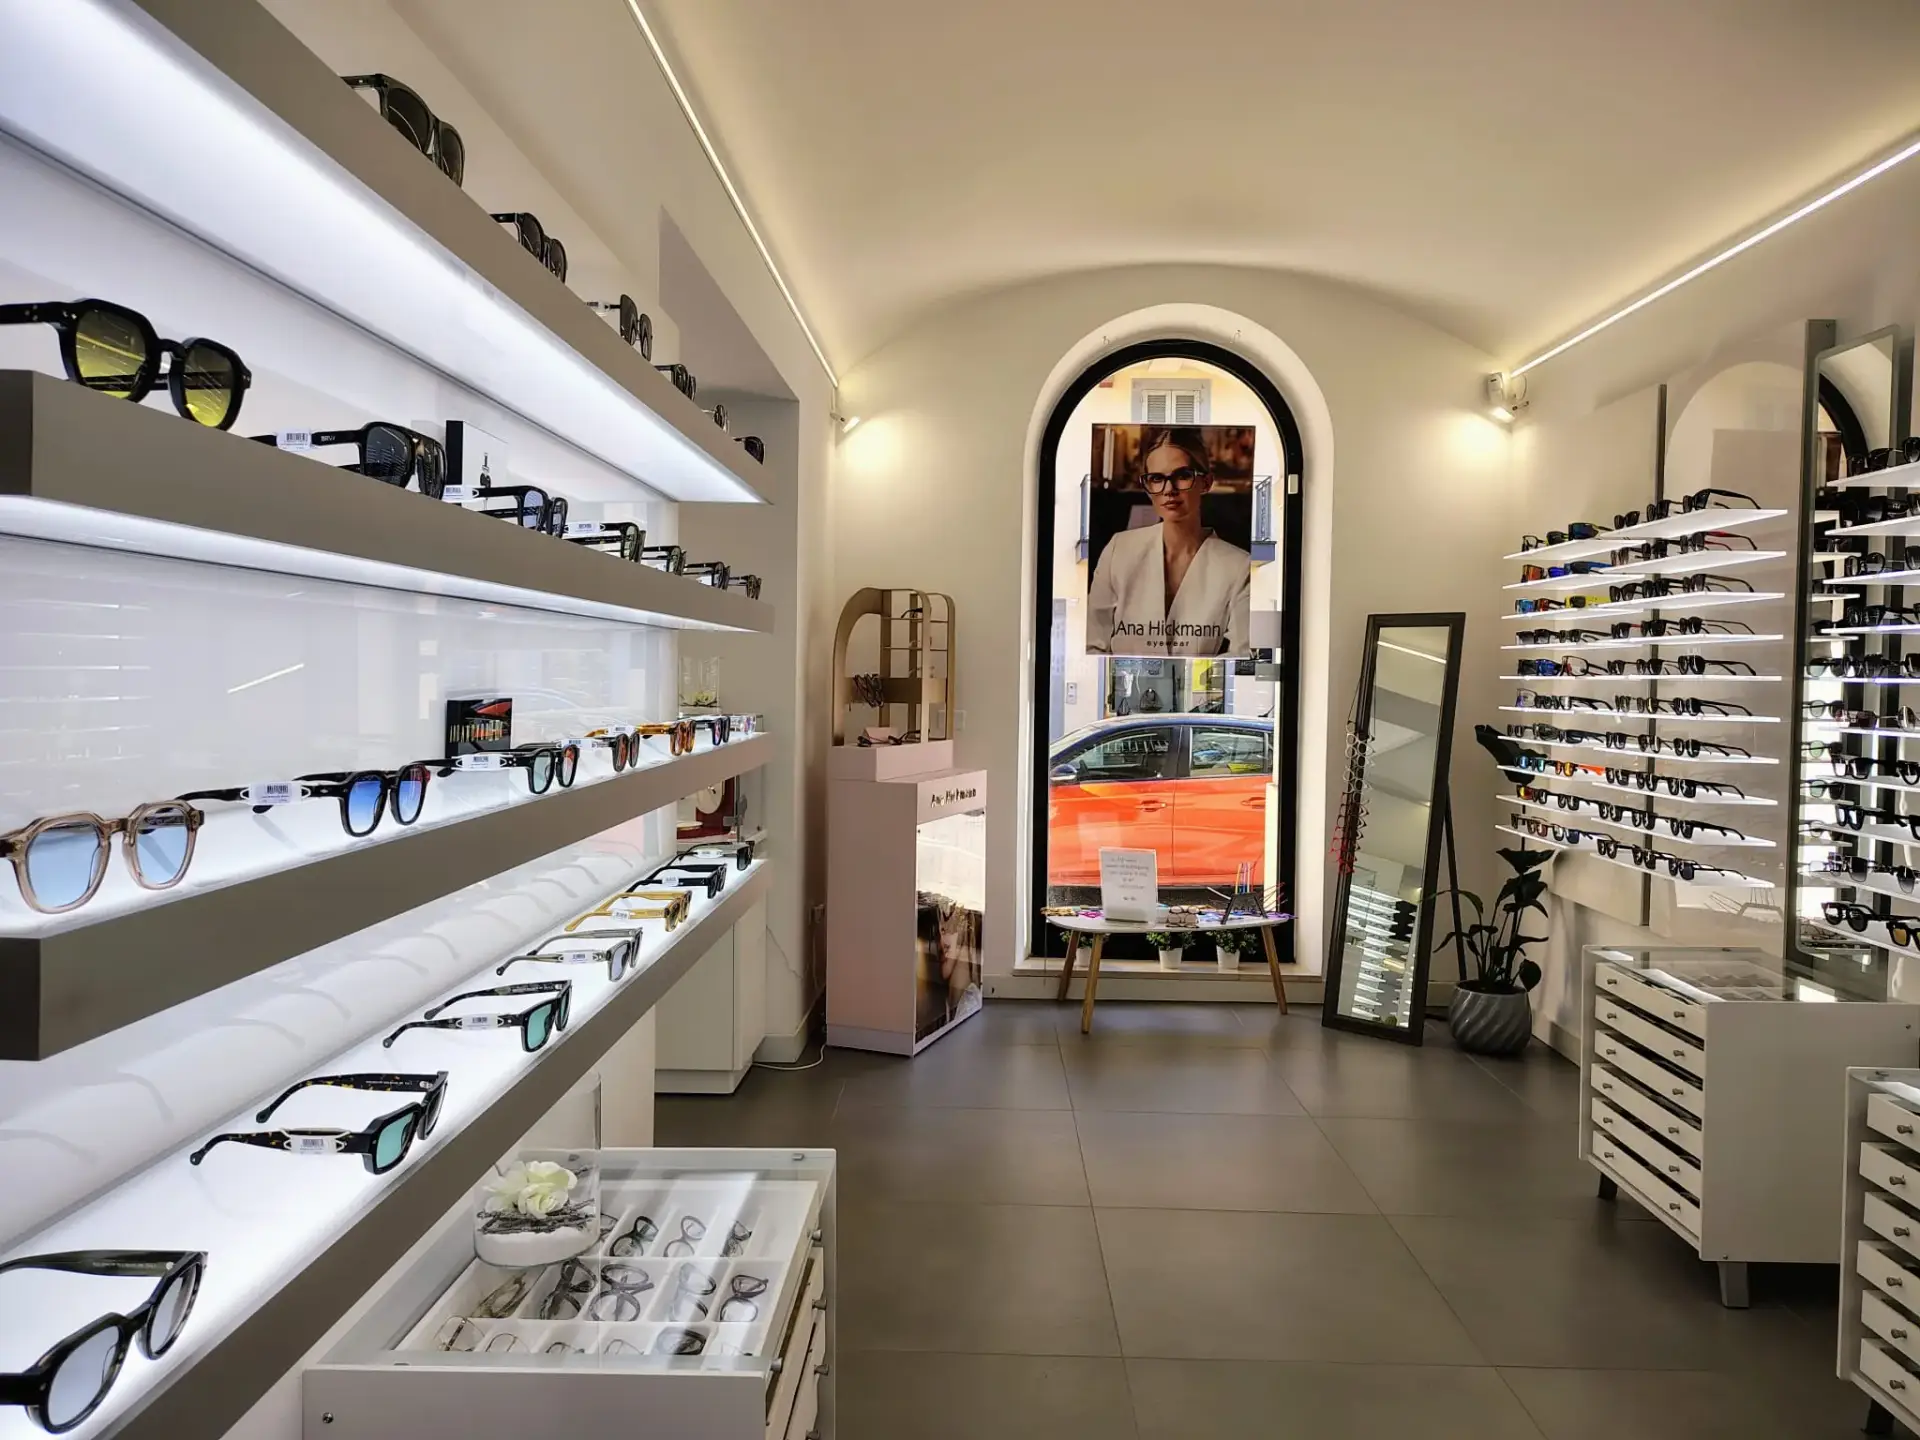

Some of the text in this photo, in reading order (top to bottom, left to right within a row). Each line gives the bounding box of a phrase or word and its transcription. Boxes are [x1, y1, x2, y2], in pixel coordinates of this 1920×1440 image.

[1115, 620, 1221, 637] Ana Hickmann
[1146, 640, 1190, 648] eyewear
